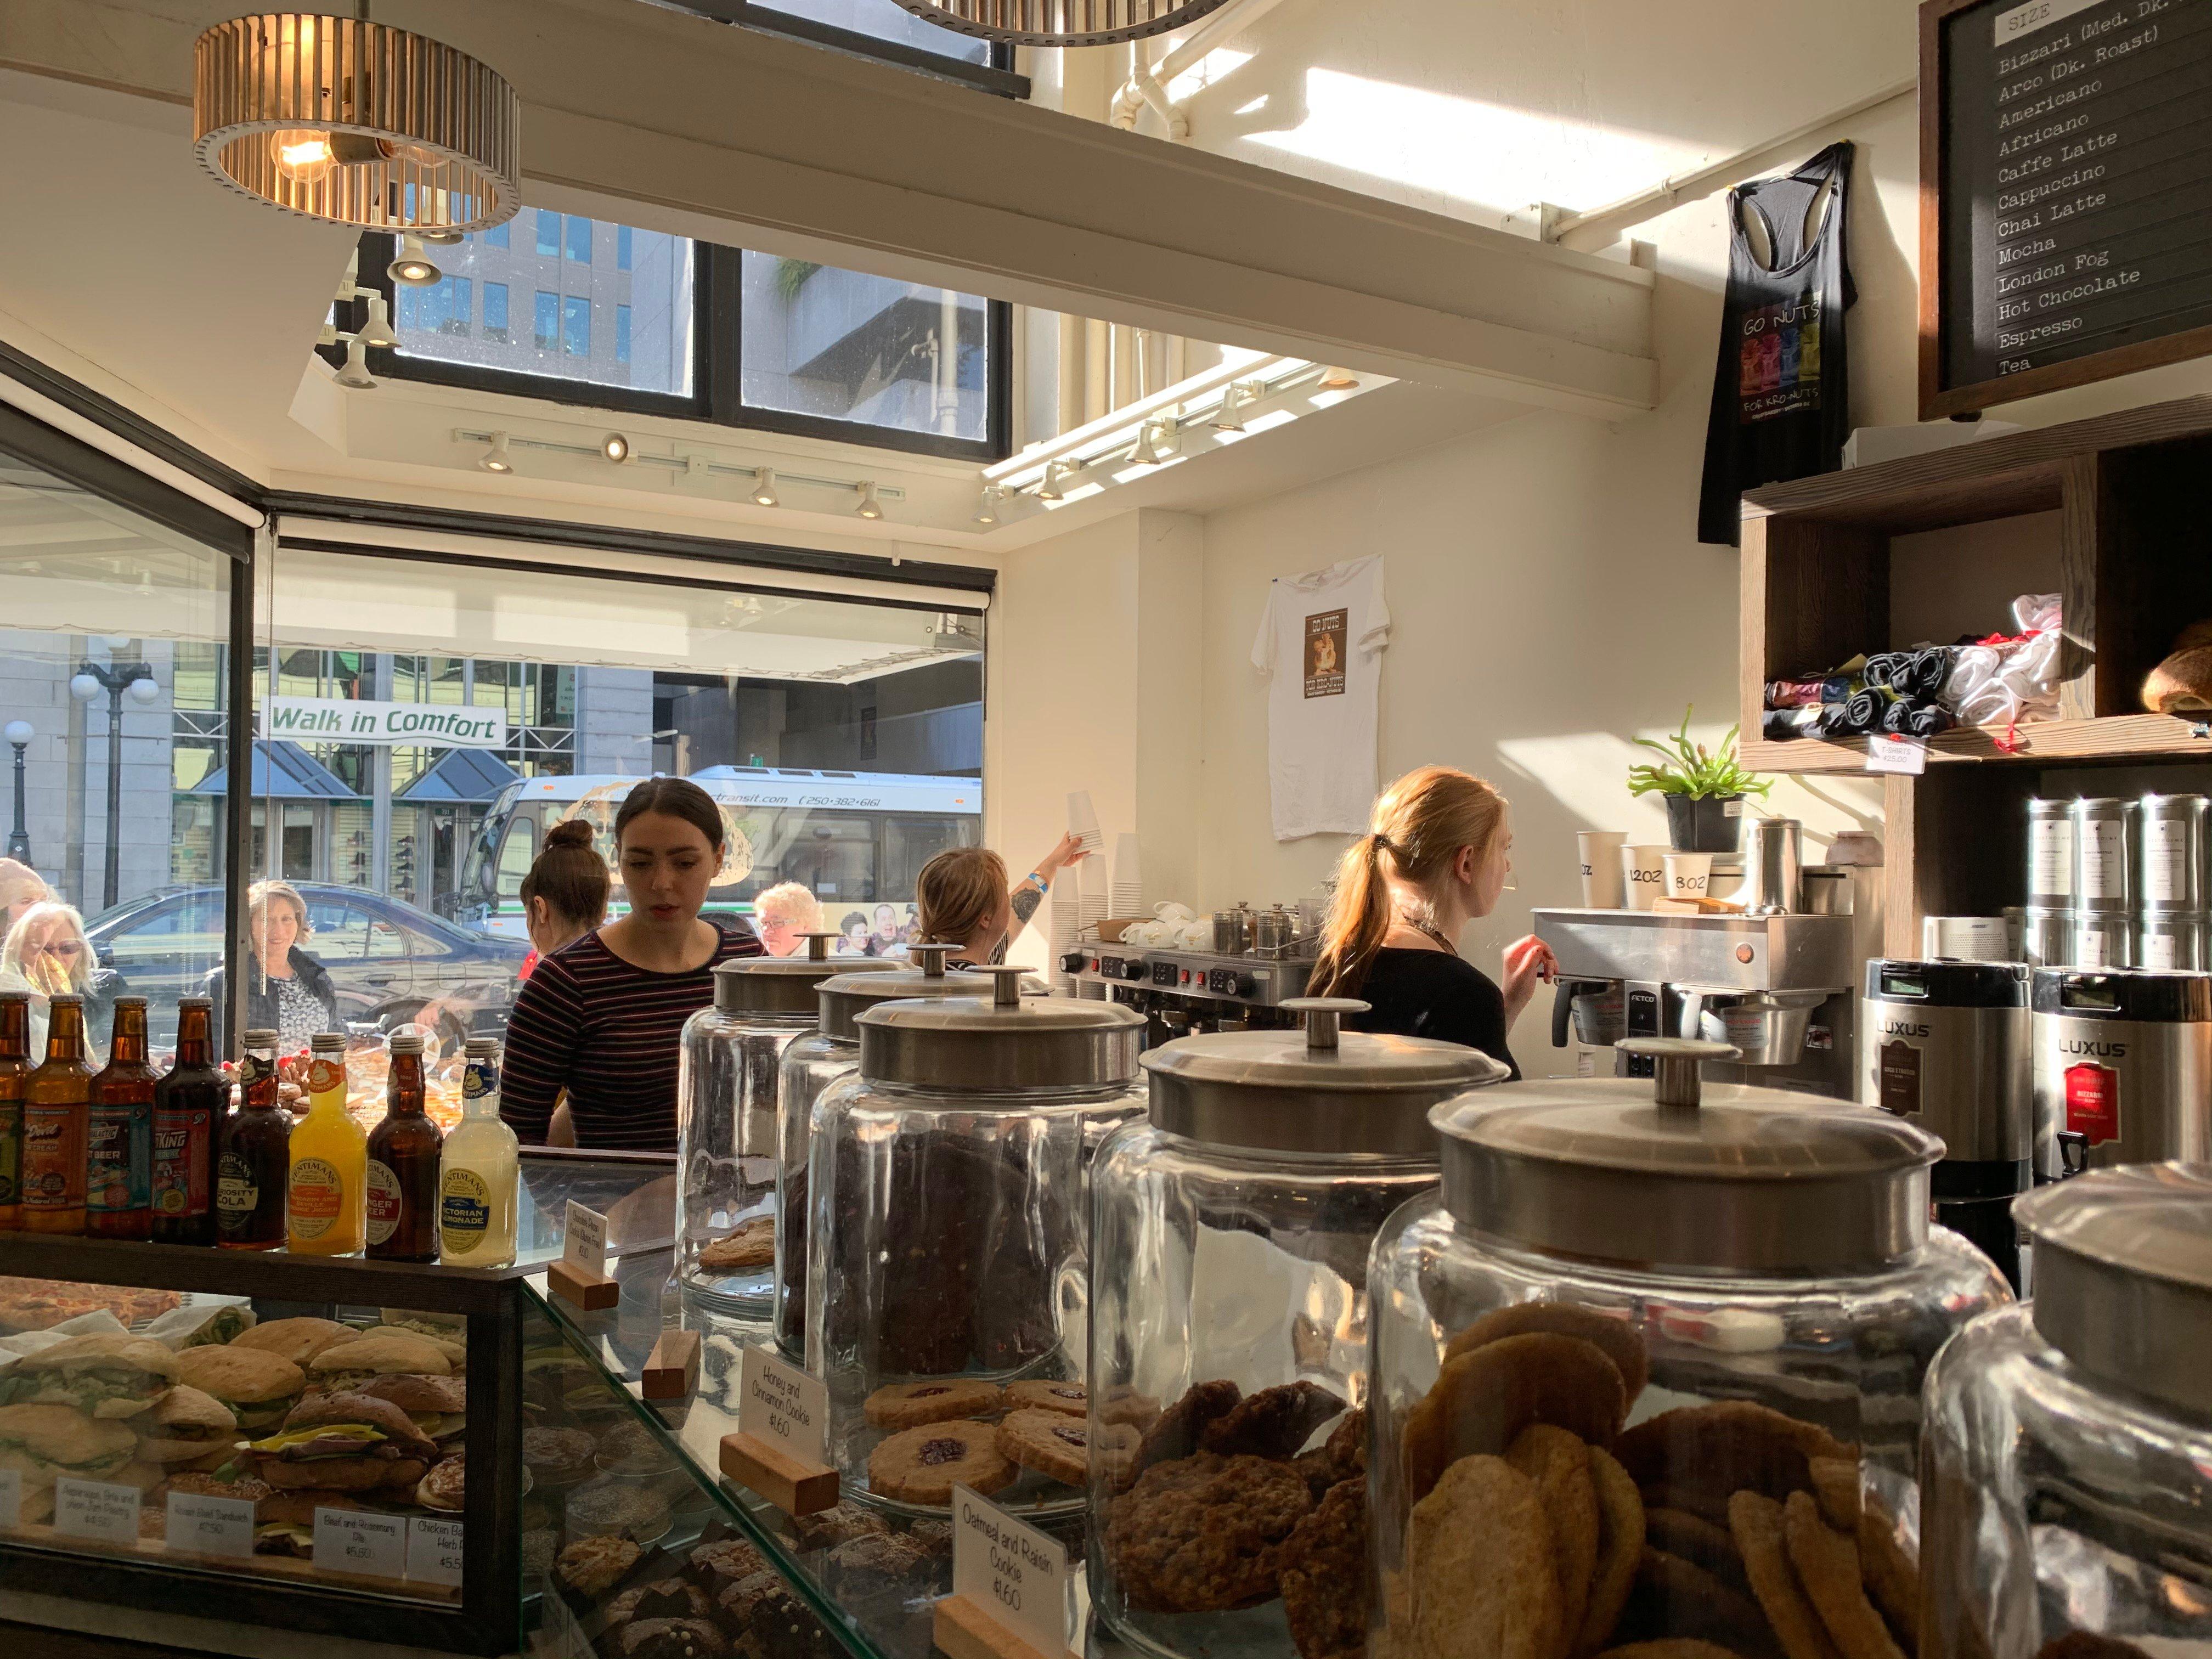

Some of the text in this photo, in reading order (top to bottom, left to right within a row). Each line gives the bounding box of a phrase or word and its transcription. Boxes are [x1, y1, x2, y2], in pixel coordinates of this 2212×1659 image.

[2008, 2, 2051, 31] SIZE
[1999, 34, 2072, 75] Bizzari
[2081, 12, 2128, 41] (Med.
[1999, 25, 2158, 103] Arco (Dk. Roast)
[1999, 80, 2103, 129] Americano
[1999, 114, 2089, 157] Africano
[1999, 131, 2118, 184] Caffe Latte
[1998, 165, 2106, 211] Cappuccino
[1998, 193, 2107, 237] Chai Latte
[1999, 236, 2056, 266] Mocha
[1999, 250, 2110, 294] London Fog
[1999, 269, 2141, 321] Hot Chocolate
[1743, 301, 1820, 335] GO NUTS
[1999, 317, 2083, 349] Espresso
[1999, 357, 2032, 376] Tea
[1743, 399, 1763, 412] FOR
[1313, 615, 1340, 633] GO NUTS
[273, 707, 496, 738] Walk in Comfort
[1877, 1020, 1930, 1037] LUXUS
[2059, 1039, 2126, 1057] LUXUS
[219, 1188, 255, 1196] RIOSITY
[368, 1199, 392, 1209] NGER
[368, 1207, 386, 1216] EER
[763, 1365, 801, 1399] Honey and
[752, 1380, 810, 1426] Cinnamon Cookie
[769, 1412, 790, 1437] $1.60
[343, 1519, 356, 1528] and
[418, 1520, 449, 1536] Chicken
[438, 1537, 456, 1550] Herb
[963, 1503, 1053, 1576] Oatmeal and Raisin
[439, 1556, 463, 1570] $5.5
[990, 1546, 1022, 1583] Cookie
[993, 1577, 1021, 1611] $1.60
